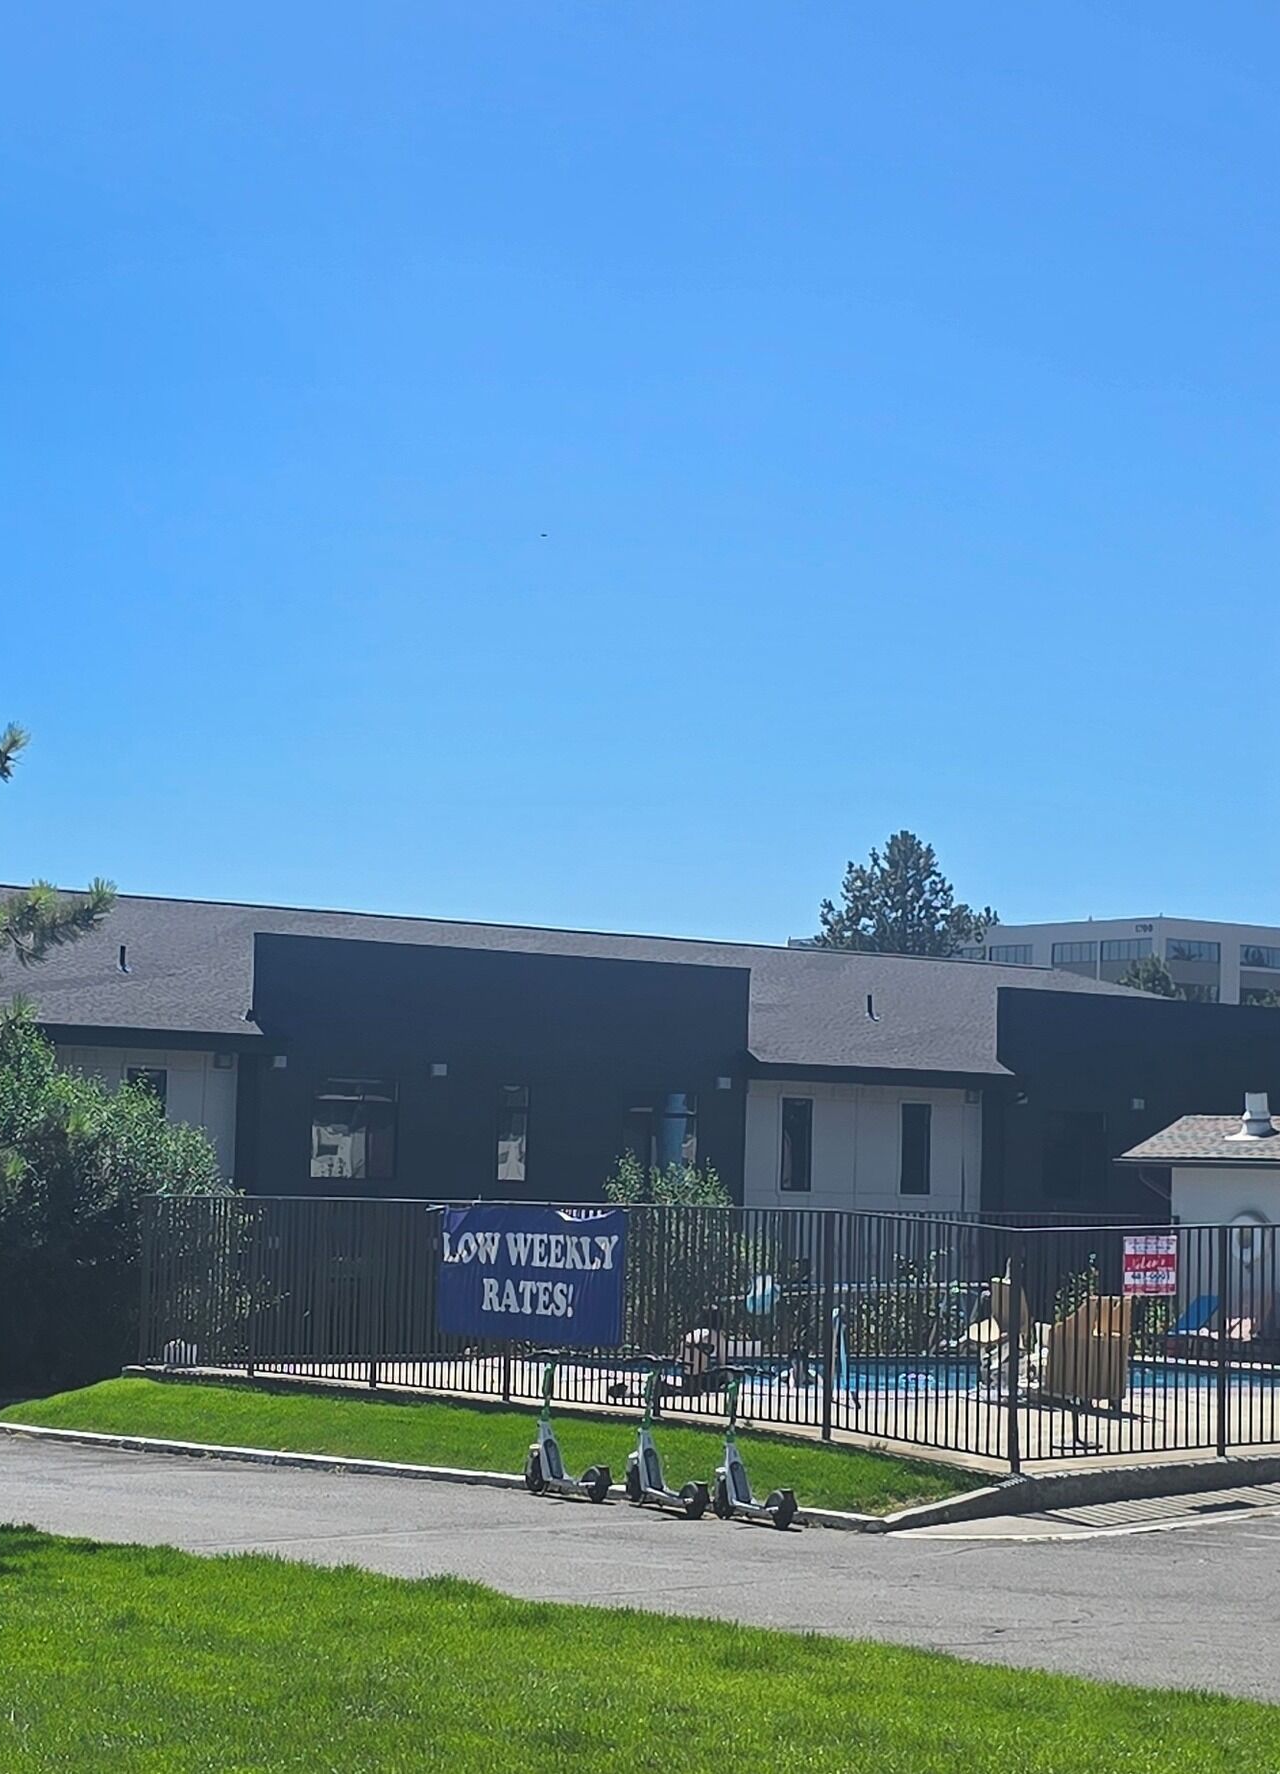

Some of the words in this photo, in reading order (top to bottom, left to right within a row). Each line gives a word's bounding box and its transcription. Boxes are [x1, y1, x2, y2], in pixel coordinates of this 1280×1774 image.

[442, 1231, 501, 1264] LOW
[505, 1233, 619, 1270] WEEKLY
[481, 1278, 574, 1318] RATES!
